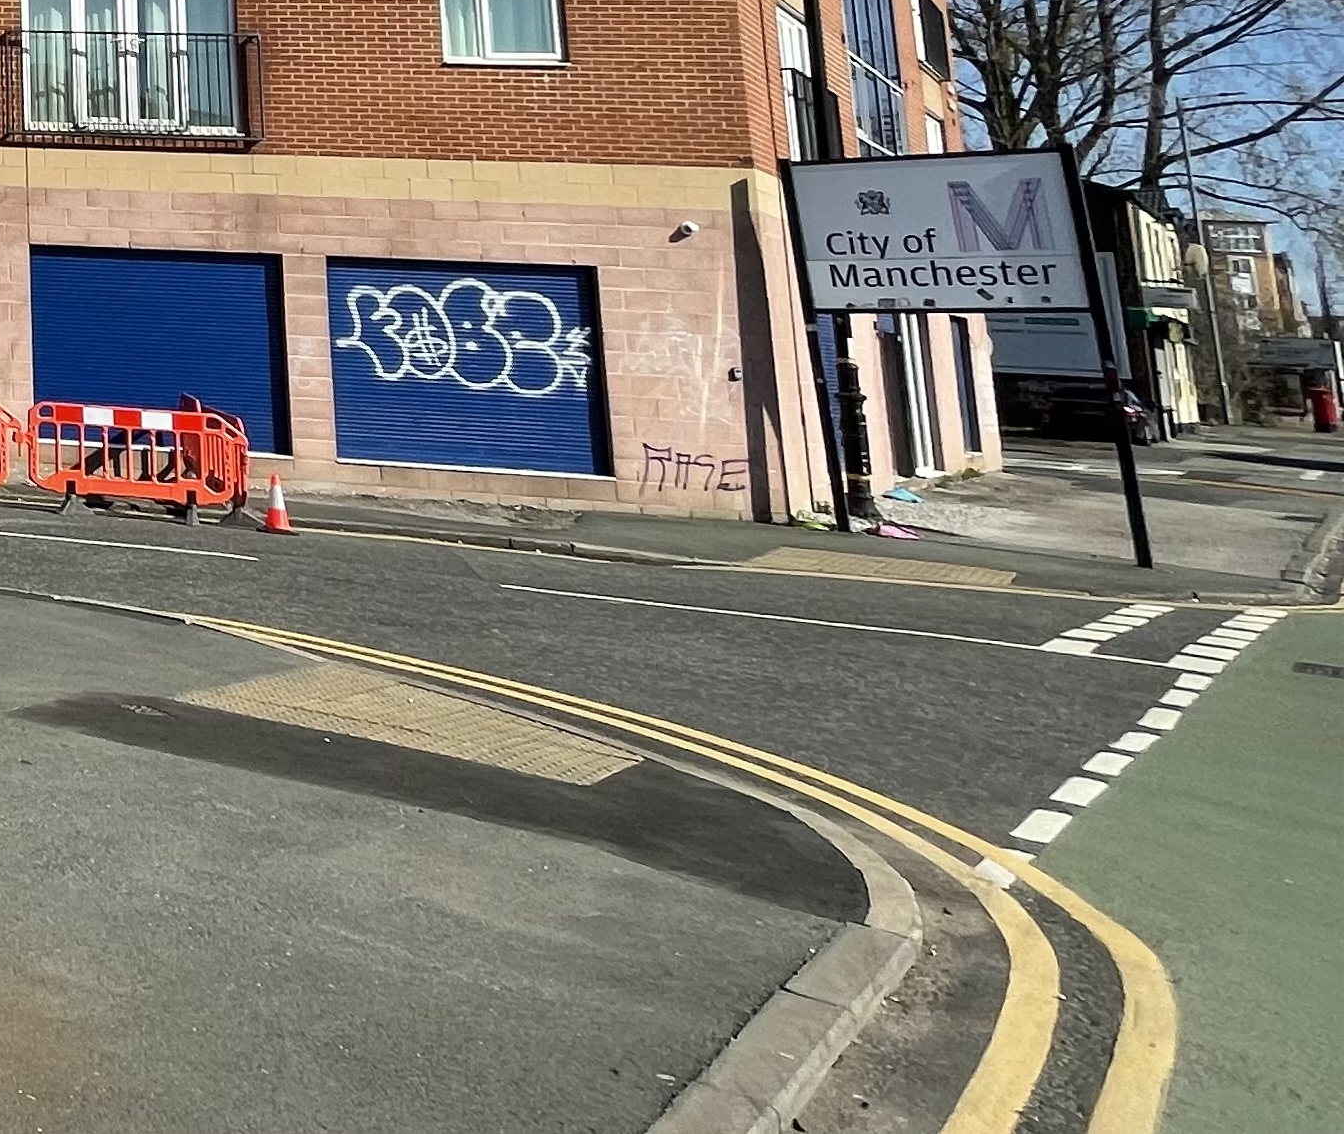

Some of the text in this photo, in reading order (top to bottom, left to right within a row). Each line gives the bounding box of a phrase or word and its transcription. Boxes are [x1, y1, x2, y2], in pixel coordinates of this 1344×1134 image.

[826, 227, 937, 260] City of
[828, 260, 1057, 288] Manchester
